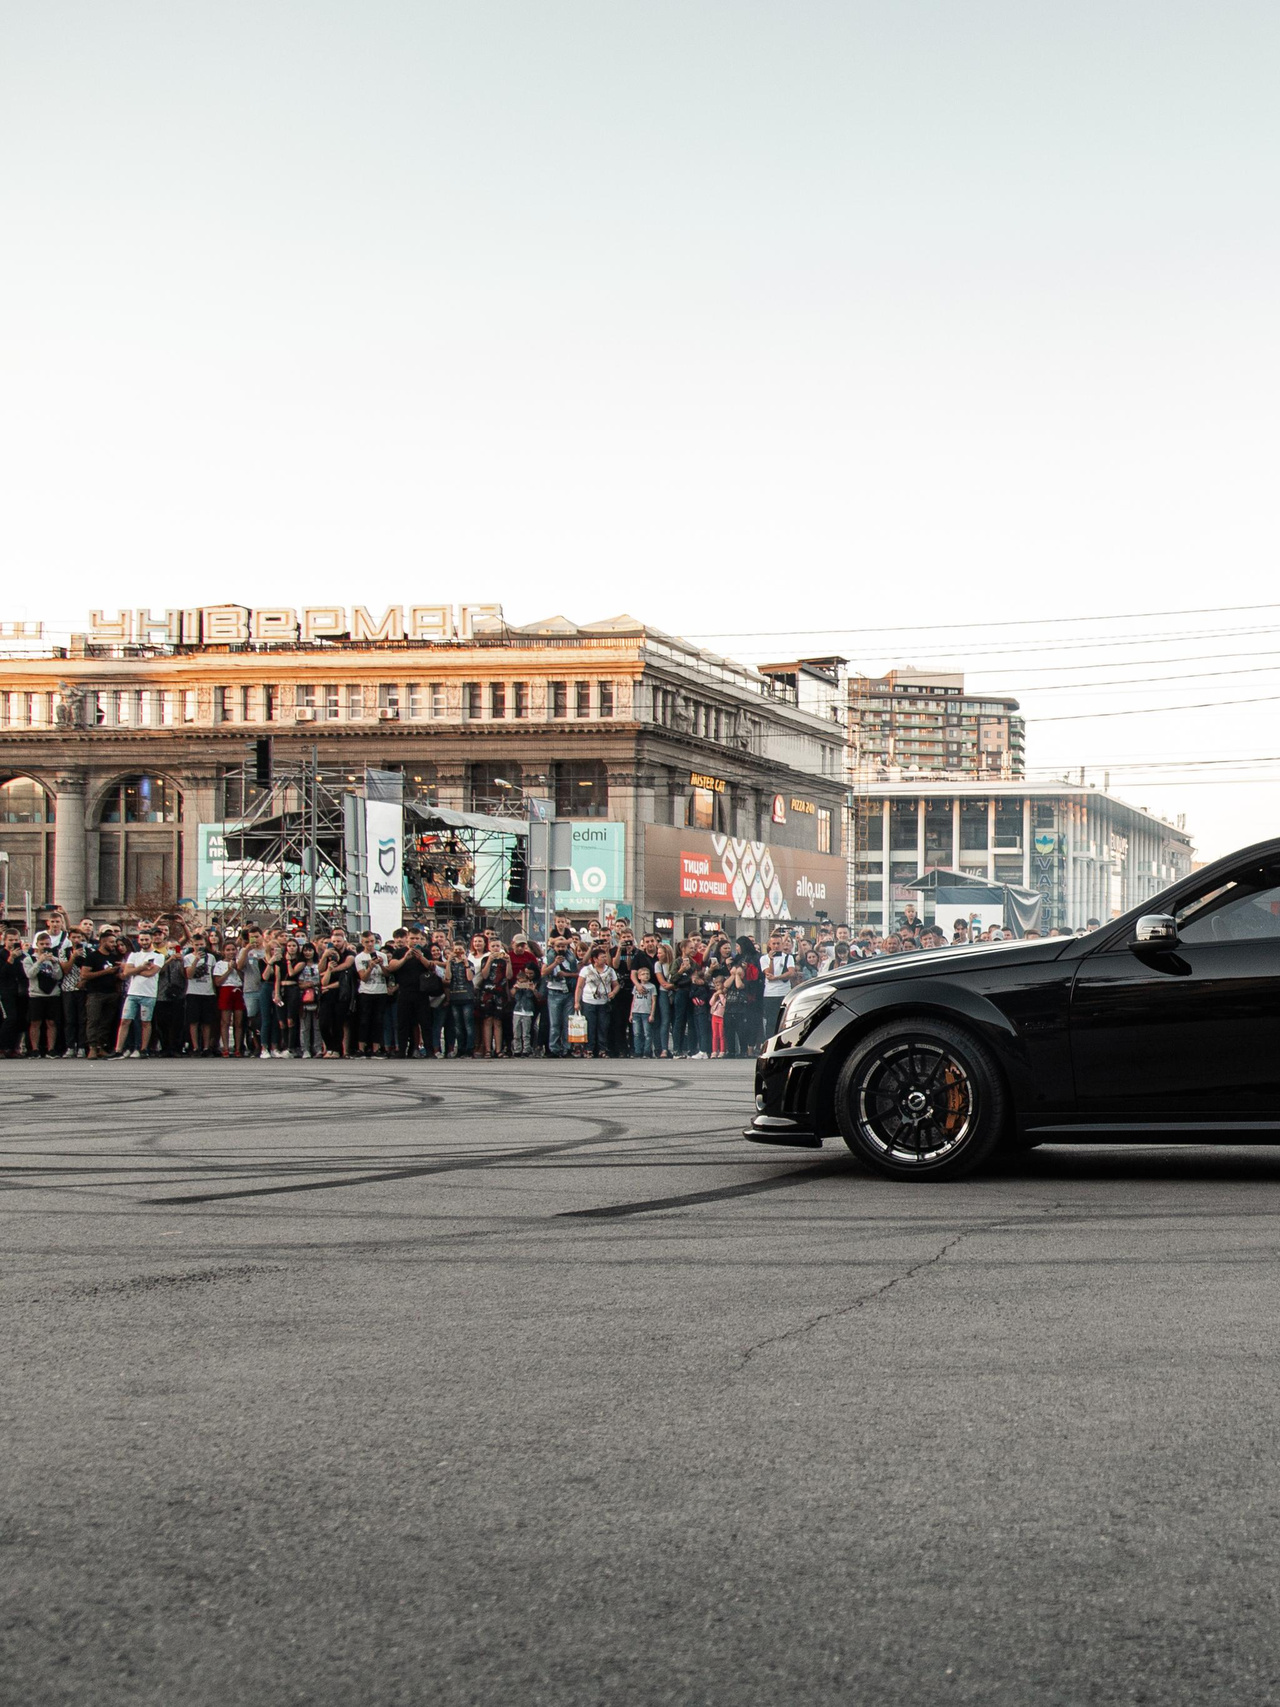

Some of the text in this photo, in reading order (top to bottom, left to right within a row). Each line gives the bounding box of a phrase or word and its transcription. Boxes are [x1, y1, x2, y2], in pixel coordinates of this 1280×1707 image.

[690, 772, 726, 793] MISTER CAT
[791, 798, 806, 812] PIZZA
[573, 828, 607, 841] edmi
[683, 858, 709, 876] ТИЦЯЙ
[373, 881, 398, 895] Дніпро
[683, 877, 728, 896] ЩО ХОЧЕШ!
[796, 875, 826, 900] allo.ua
